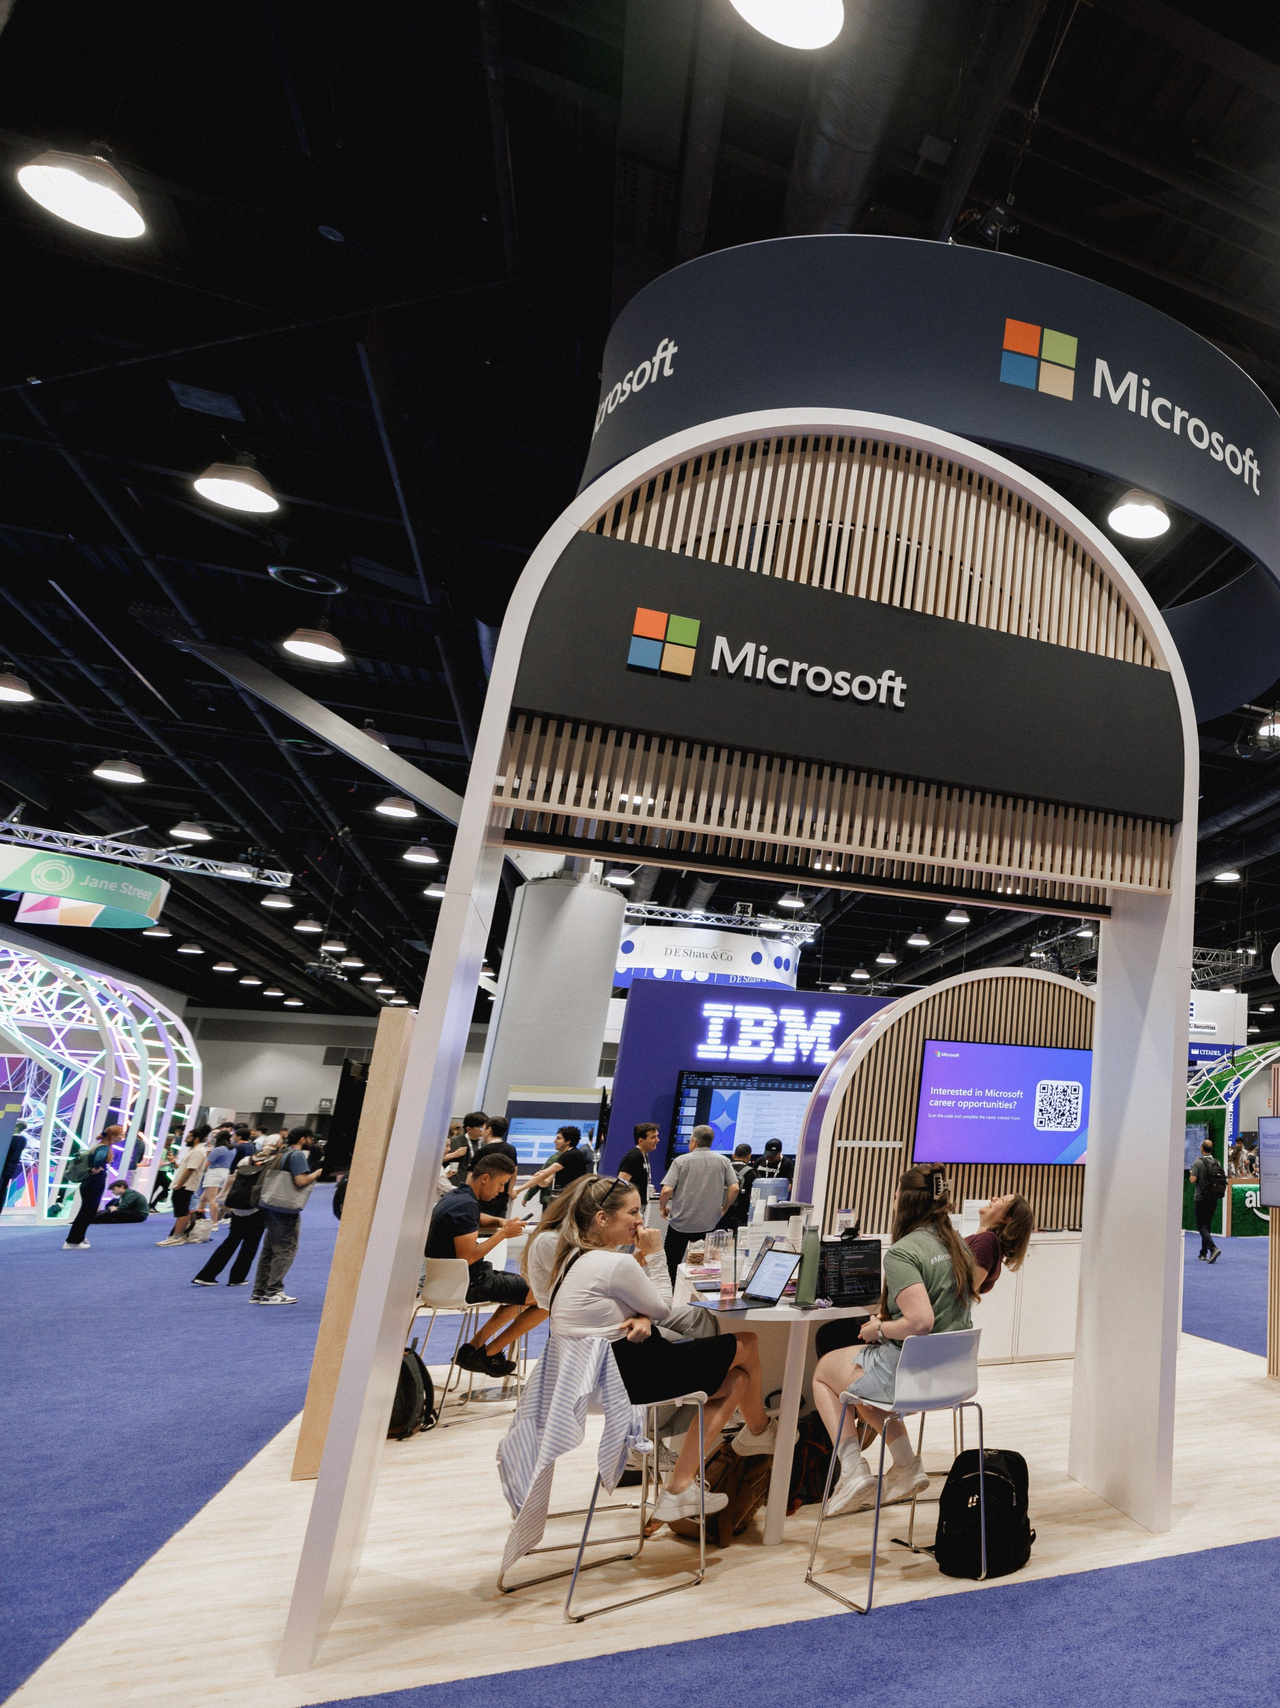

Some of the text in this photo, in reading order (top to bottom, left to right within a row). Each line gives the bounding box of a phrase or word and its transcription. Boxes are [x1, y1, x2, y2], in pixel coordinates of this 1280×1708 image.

[593, 338, 678, 433] crosoft
[1092, 357, 1261, 496] Microsoft
[710, 636, 907, 708] Microsoft
[79, 875, 152, 901] Jane Street
[682, 948, 710, 960] Shaw
[711, 951, 719, 960] &
[697, 1003, 842, 1064] IBM
[930, 1086, 1023, 1099] Interested in Microsoft
[929, 1099, 1017, 1110] career opportunities?
[1263, 1132, 1280, 1140] Microsoft
[1263, 1142, 1279, 1150] Research
[930, 1253, 951, 1265] #Micro
